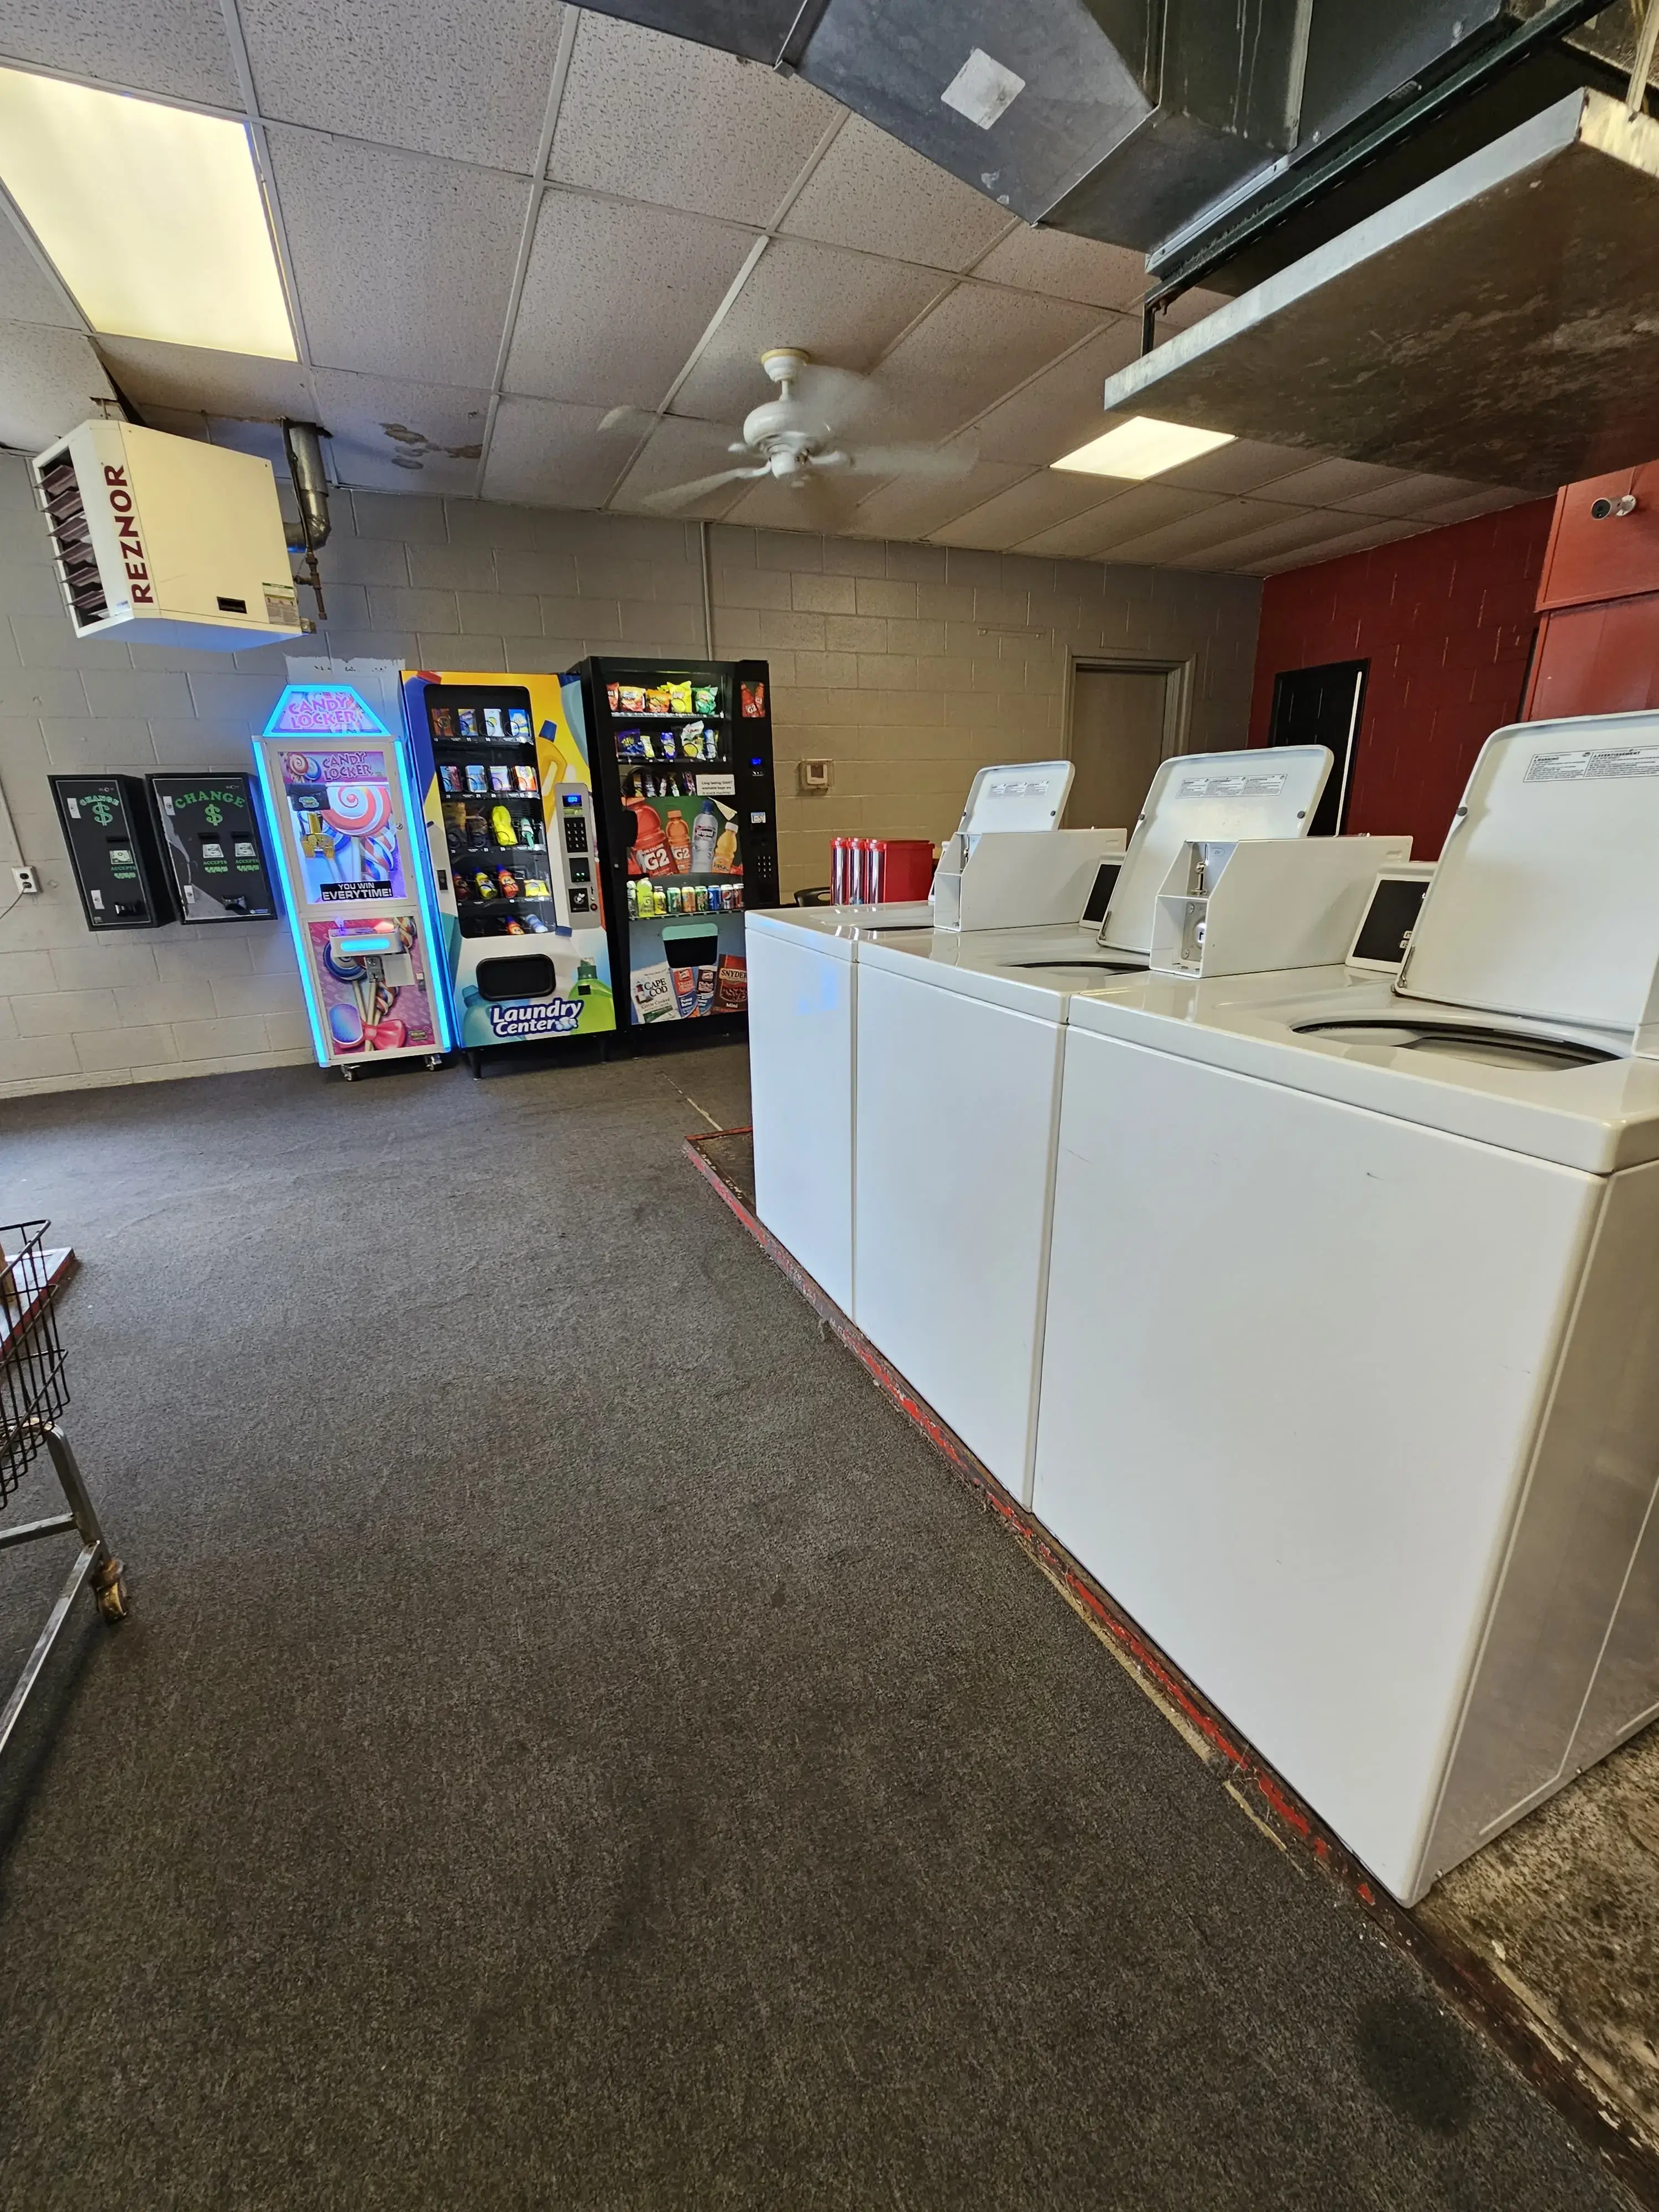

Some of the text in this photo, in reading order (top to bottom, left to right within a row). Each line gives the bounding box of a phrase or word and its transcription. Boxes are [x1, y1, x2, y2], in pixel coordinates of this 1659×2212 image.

[104, 465, 154, 603] REZNOR
[289, 697, 347, 714] CANDY
[290, 711, 356, 728] LOCKER
[322, 752, 366, 768] CANDY
[323, 765, 372, 780] LOCKER
[80, 795, 119, 806] CHANGE
[175, 791, 245, 809] CHANGE
[92, 802, 113, 826] $
[205, 804, 223, 826] $
[644, 848, 670, 870] G2
[674, 848, 690, 860] G2
[322, 888, 392, 900] EVERYTIME!
[644, 978, 666, 990] CAPE
[649, 985, 668, 997] COD
[493, 1000, 582, 1023] Laundry
[496, 1019, 555, 1035] Center
